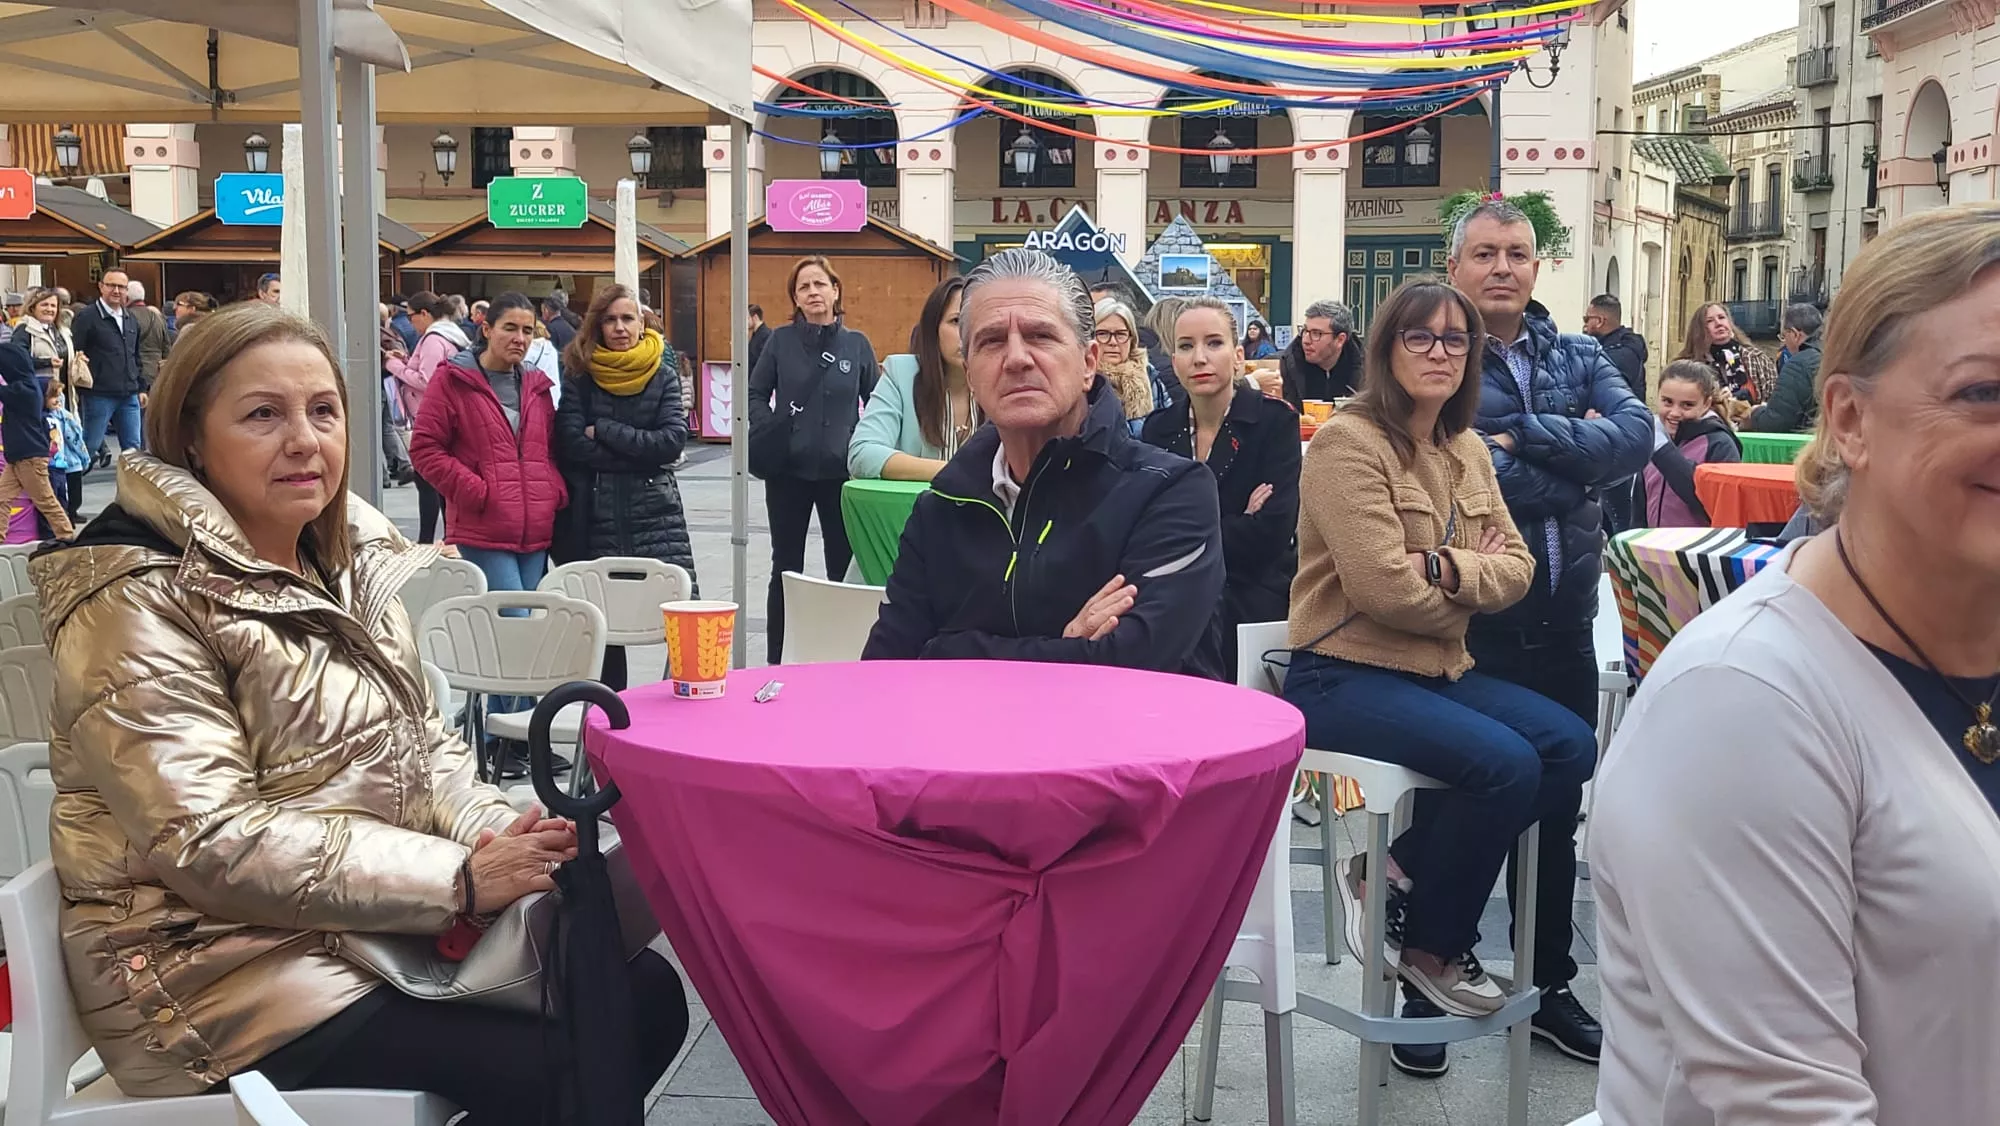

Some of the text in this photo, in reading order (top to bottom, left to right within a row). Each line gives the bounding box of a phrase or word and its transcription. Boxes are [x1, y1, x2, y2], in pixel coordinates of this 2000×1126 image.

[532, 182, 543, 200] Z
[509, 204, 566, 216] ZUCRER
[1023, 227, 1127, 253] ARAGÓN
